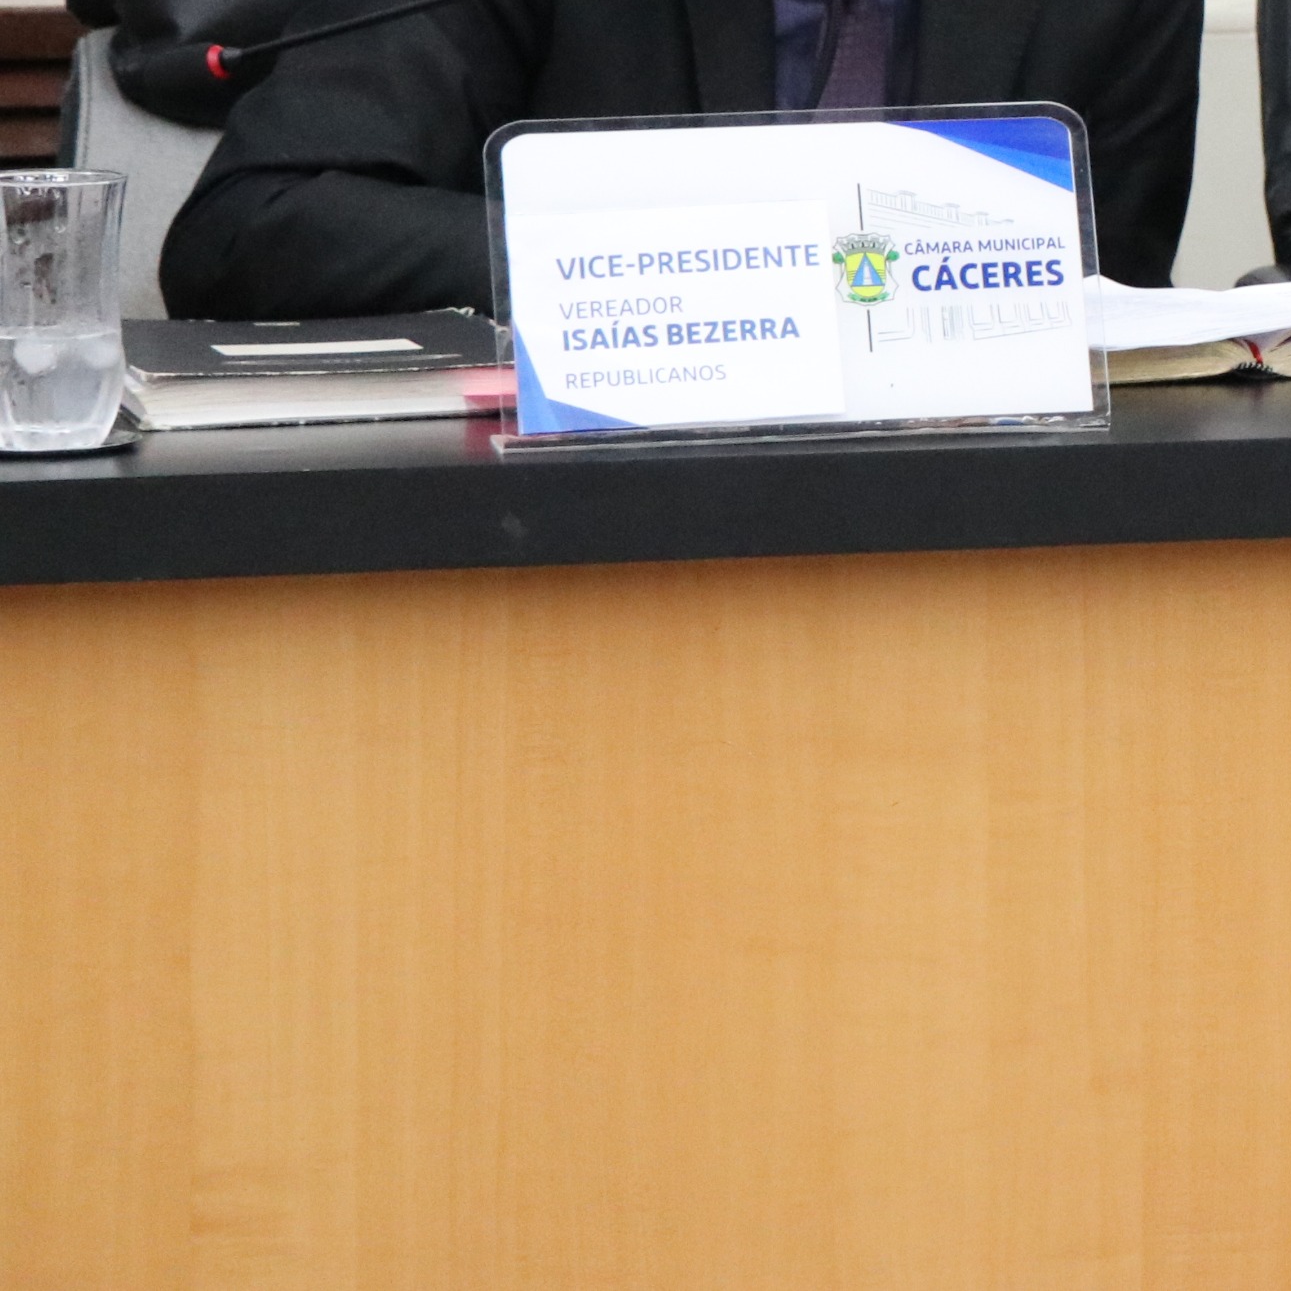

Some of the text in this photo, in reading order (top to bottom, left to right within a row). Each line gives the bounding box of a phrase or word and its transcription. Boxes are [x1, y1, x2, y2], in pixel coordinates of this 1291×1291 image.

[904, 236, 1066, 256] CÂMARA MUNICIPAL
[555, 243, 820, 281] VICE-PRESIDENTE
[911, 256, 1065, 292] CÁCERES
[559, 295, 684, 320] VEREADOR
[562, 316, 800, 351] ISAÍAS BEZERRA
[565, 363, 727, 389] REPUBLICANOS
